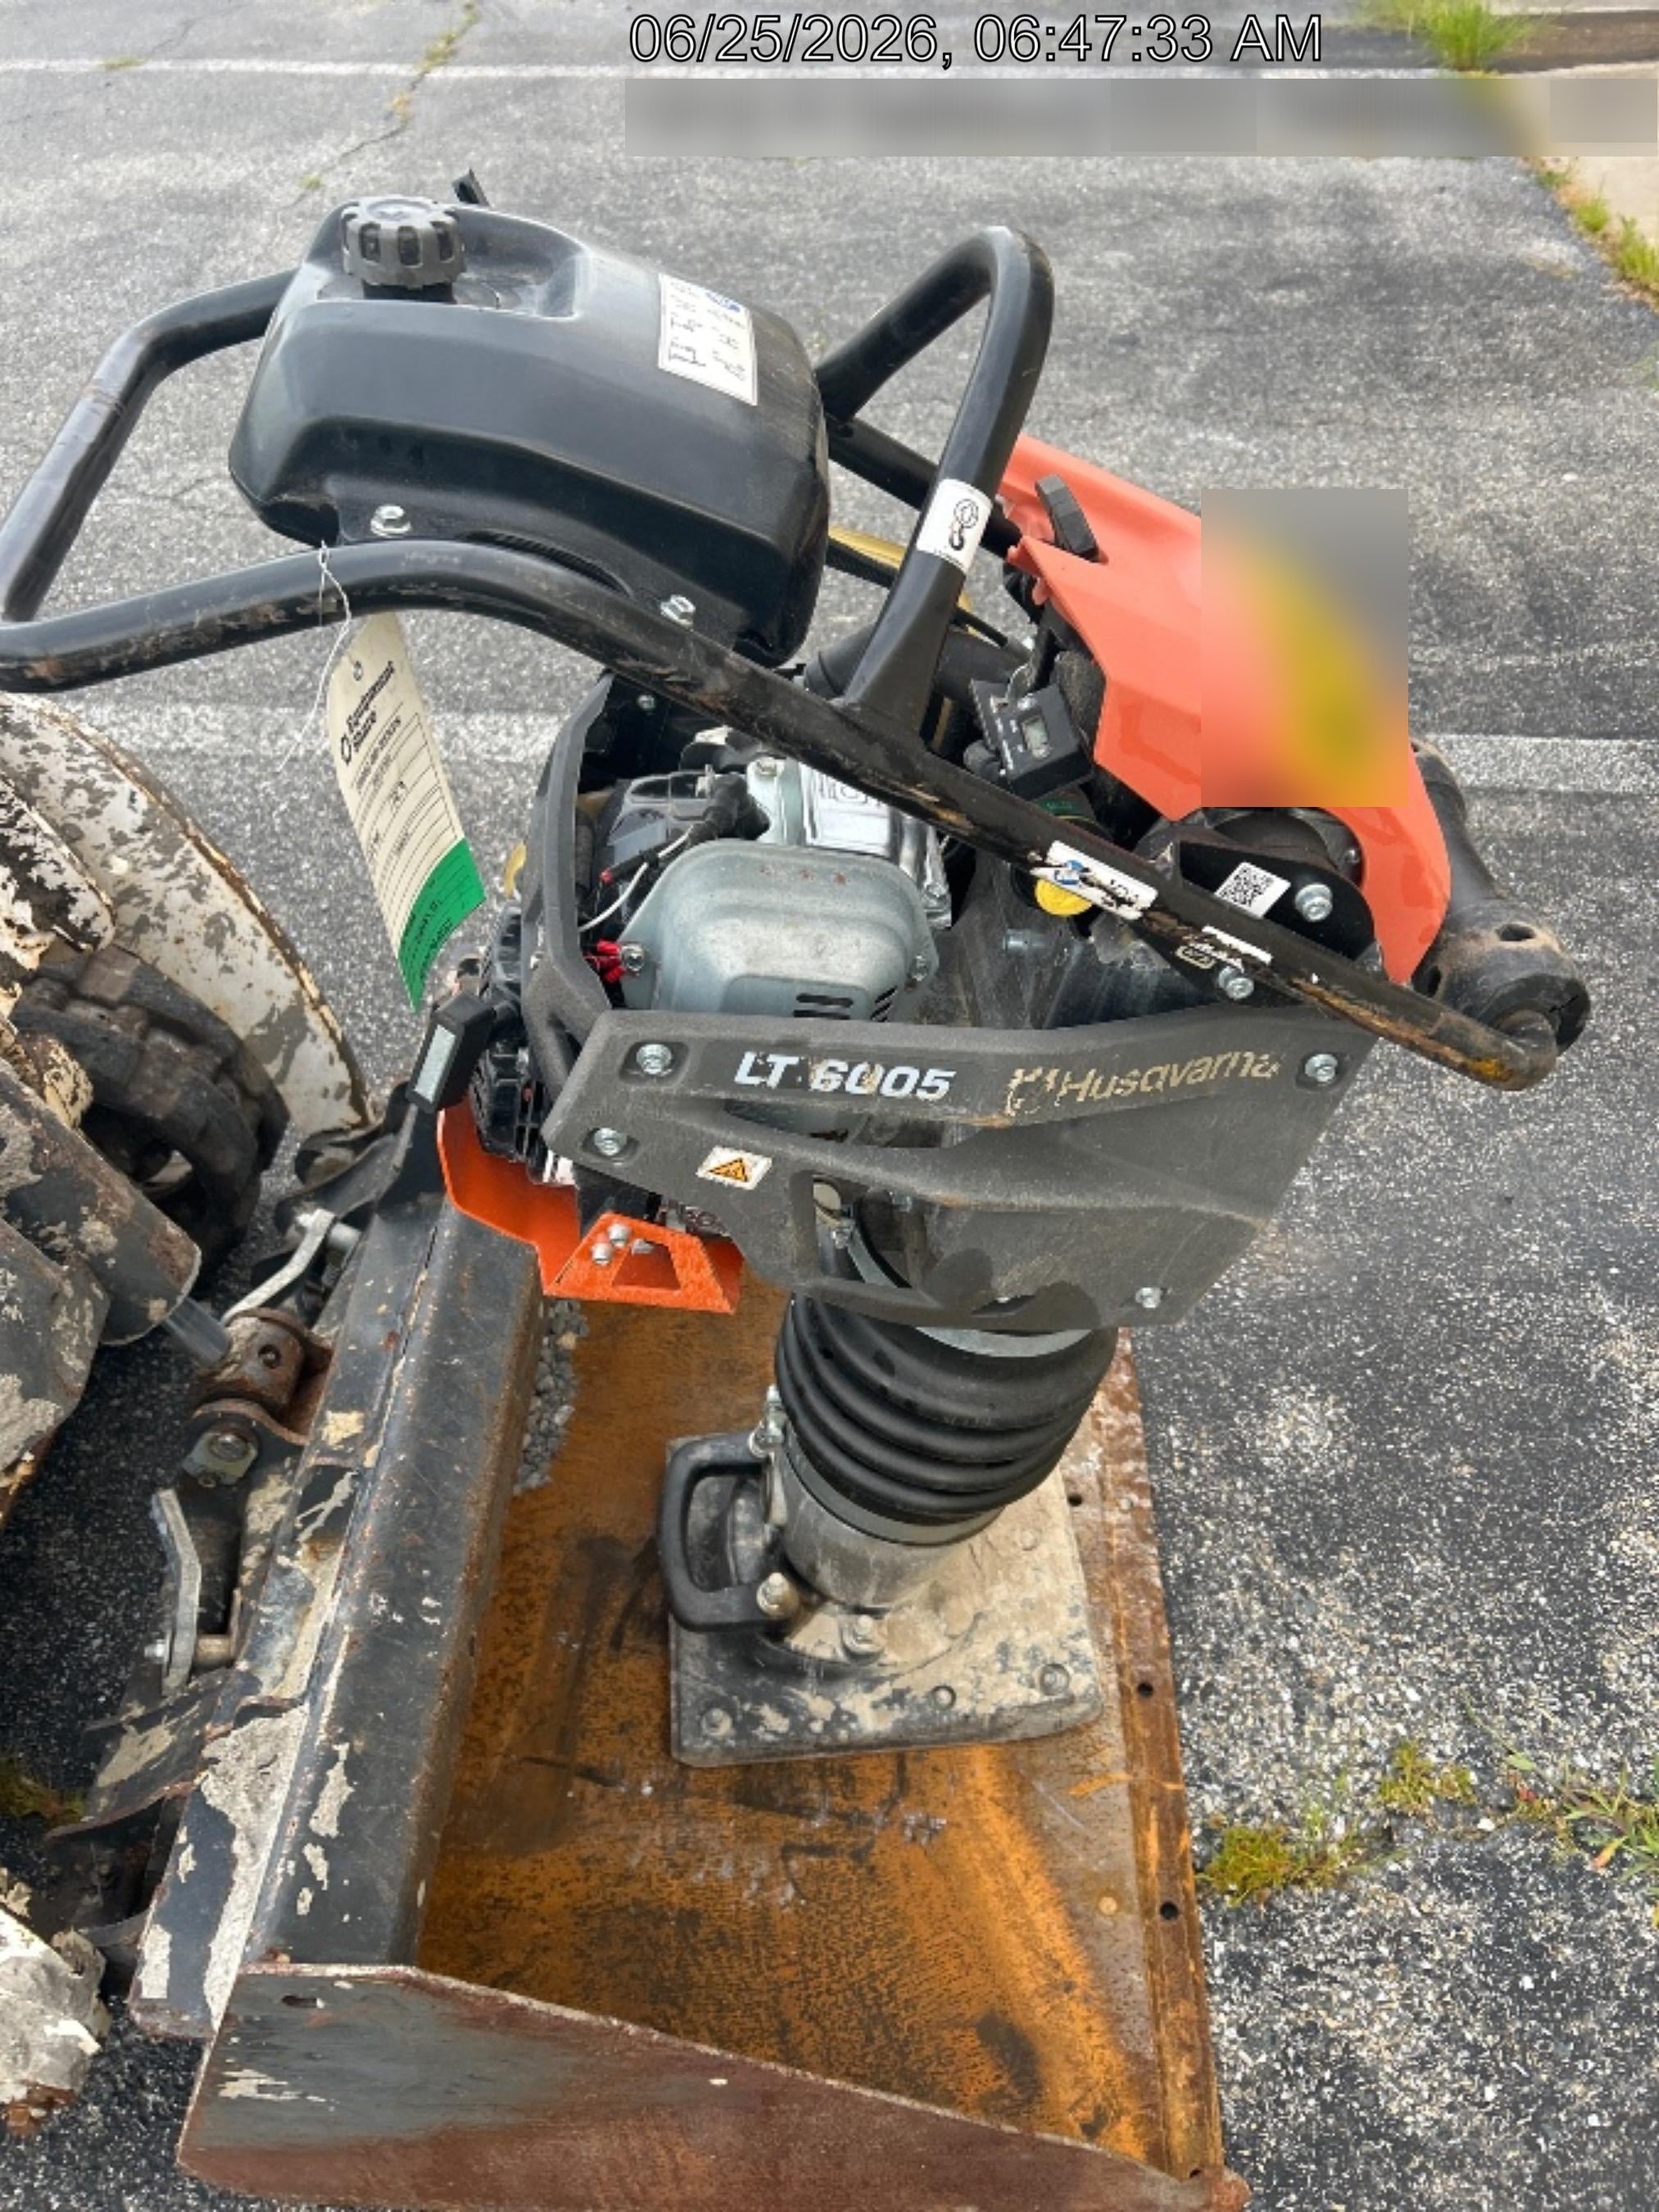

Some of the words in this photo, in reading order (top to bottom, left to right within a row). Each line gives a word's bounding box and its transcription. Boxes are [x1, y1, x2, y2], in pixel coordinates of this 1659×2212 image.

[735, 1050, 800, 1090] LT
[809, 1060, 955, 1101] 6005
[1060, 1051, 1281, 1103] Husqvarna
